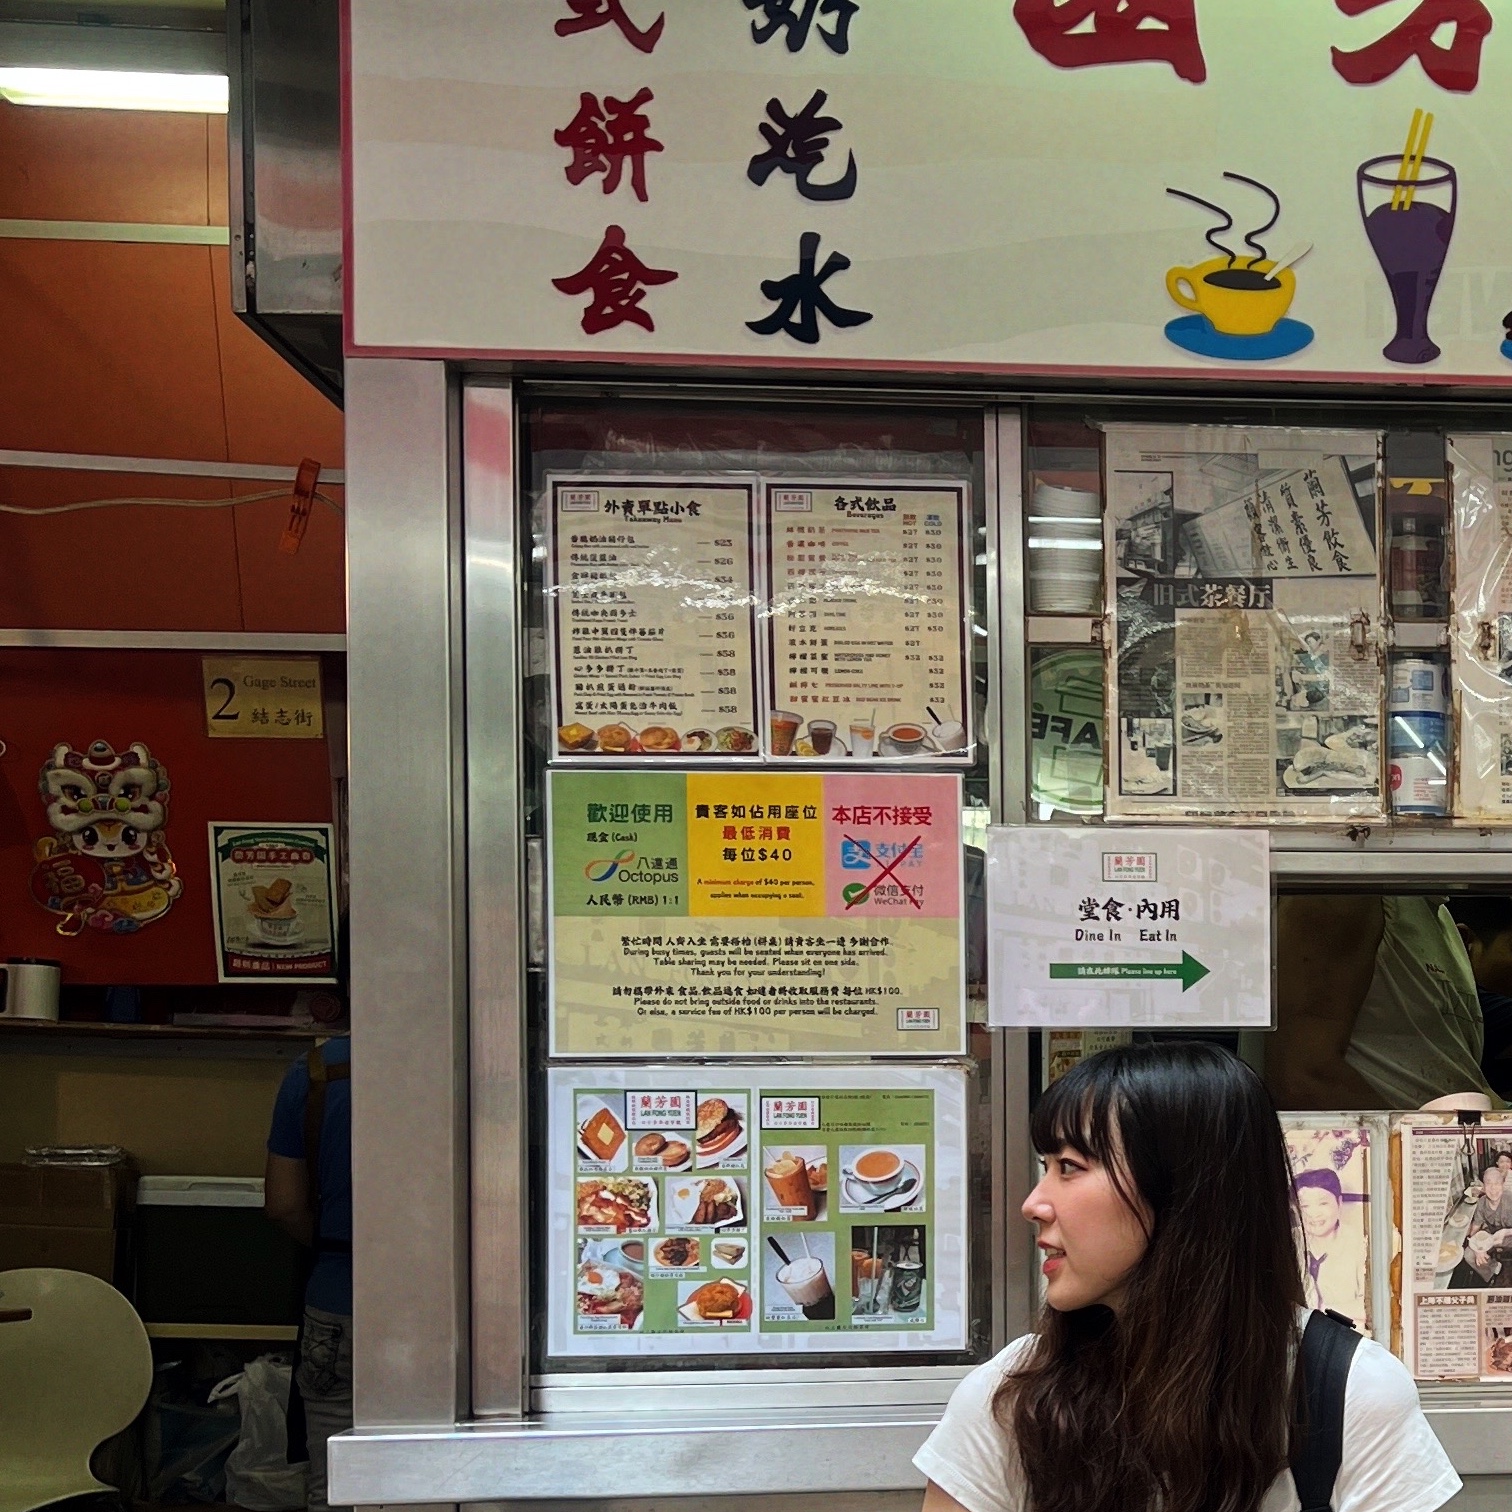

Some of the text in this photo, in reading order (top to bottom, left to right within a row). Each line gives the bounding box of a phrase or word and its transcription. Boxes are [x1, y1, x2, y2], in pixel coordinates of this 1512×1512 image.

[834, 496, 897, 512] 各式飲品
[243, 675, 317, 690] Gage Street
[210, 678, 241, 721] 2
[251, 708, 314, 727] 結志街
[586, 803, 673, 824] 歡迎使用
[695, 804, 817, 819] 貴客如佔用座位
[831, 805, 933, 826] 本店不接受
[722, 825, 791, 841] 最低消費
[722, 847, 793, 862] 每位$40
[618, 870, 679, 885] Octopus
[733, 878, 754, 887] charge
[755, 878, 762, 886] of
[763, 878, 779, 886] $40
[586, 893, 625, 906] 人民幣
[1075, 928, 1177, 941] Dine In Eat In
[623, 948, 650, 957] During
[651, 948, 670, 957] busy
[744, 948, 754, 956] be
[678, 958, 706, 967] sharing
[727, 958, 737, 966] be
[772, 958, 799, 966] Please
[691, 967, 715, 976] Thank
[717, 969, 731, 978] you
[733, 967, 745, 976] for
[747, 969, 766, 978] your
[1121, 967, 1141, 975] Please
[634, 997, 661, 1005] Please
[662, 997, 673, 1005] do
[674, 997, 687, 1005] not
[689, 997, 710, 1007] bring
[742, 997, 761, 1005] food
[774, 997, 798, 1005] drinks
[637, 1007, 647, 1015] Or
[723, 1007, 732, 1015] of
[640, 1095, 682, 1108] 蘭芳園
[773, 1100, 808, 1112] 蘭芳園
